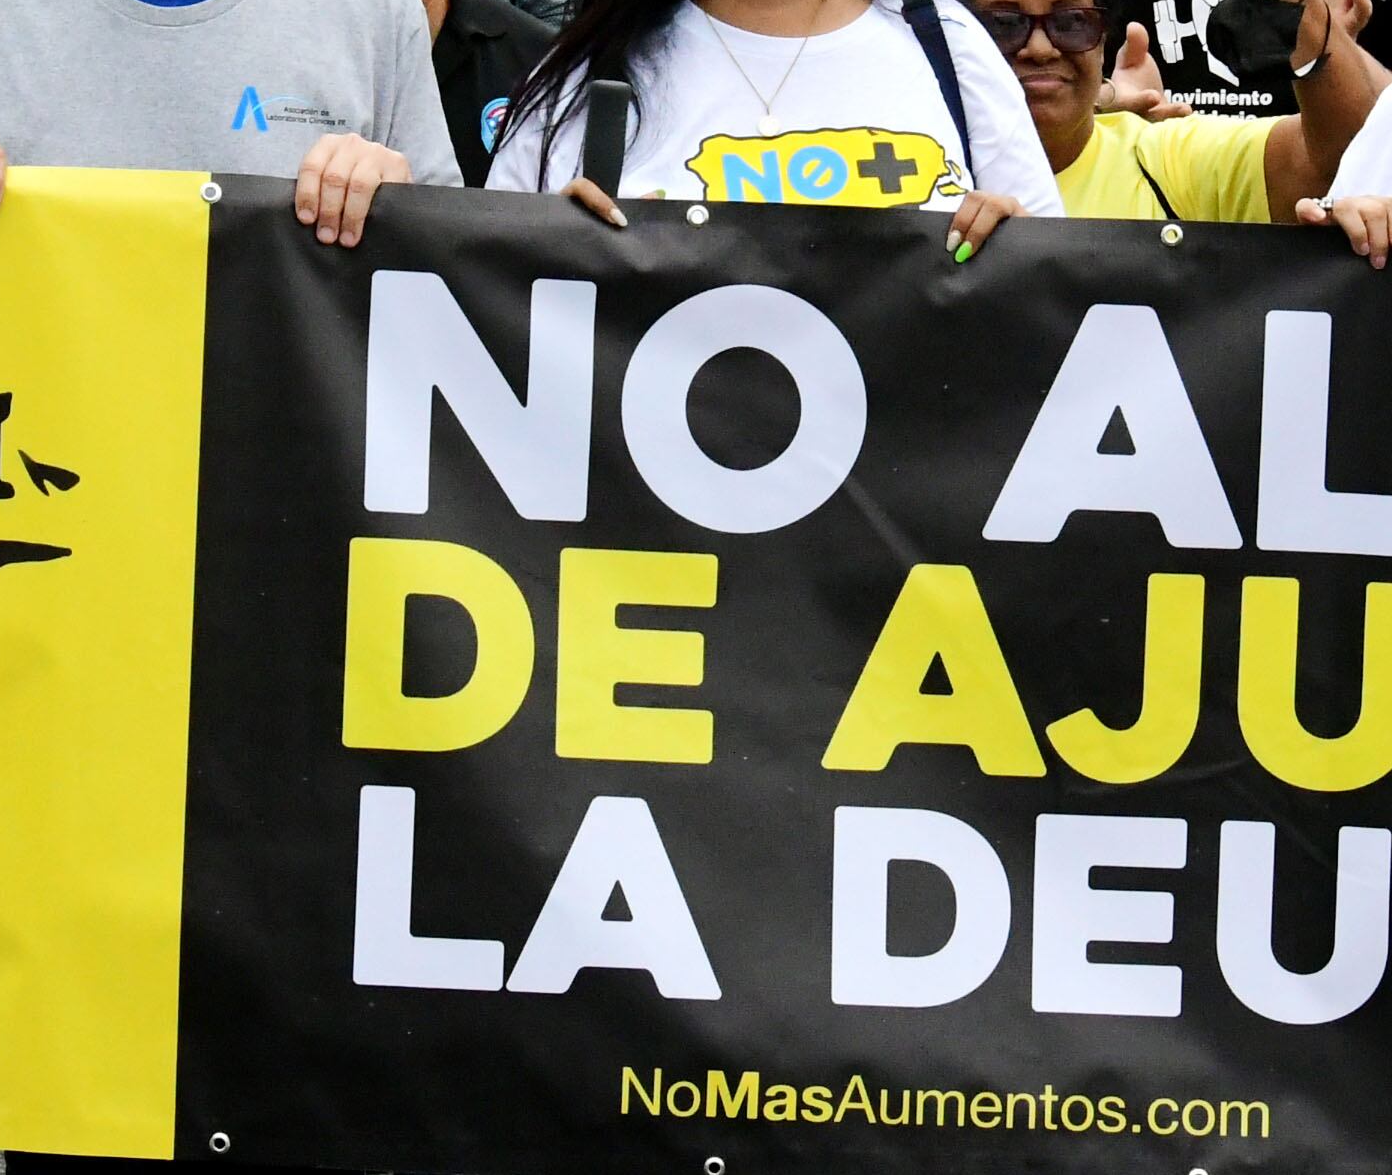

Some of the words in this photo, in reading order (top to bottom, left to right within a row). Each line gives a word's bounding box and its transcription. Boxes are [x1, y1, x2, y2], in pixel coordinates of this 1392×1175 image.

[363, 269, 868, 534] NO
[341, 537, 720, 764] DE
[352, 784, 723, 1001] LA
[620, 1066, 1270, 1138] NoMasAumentos.com
